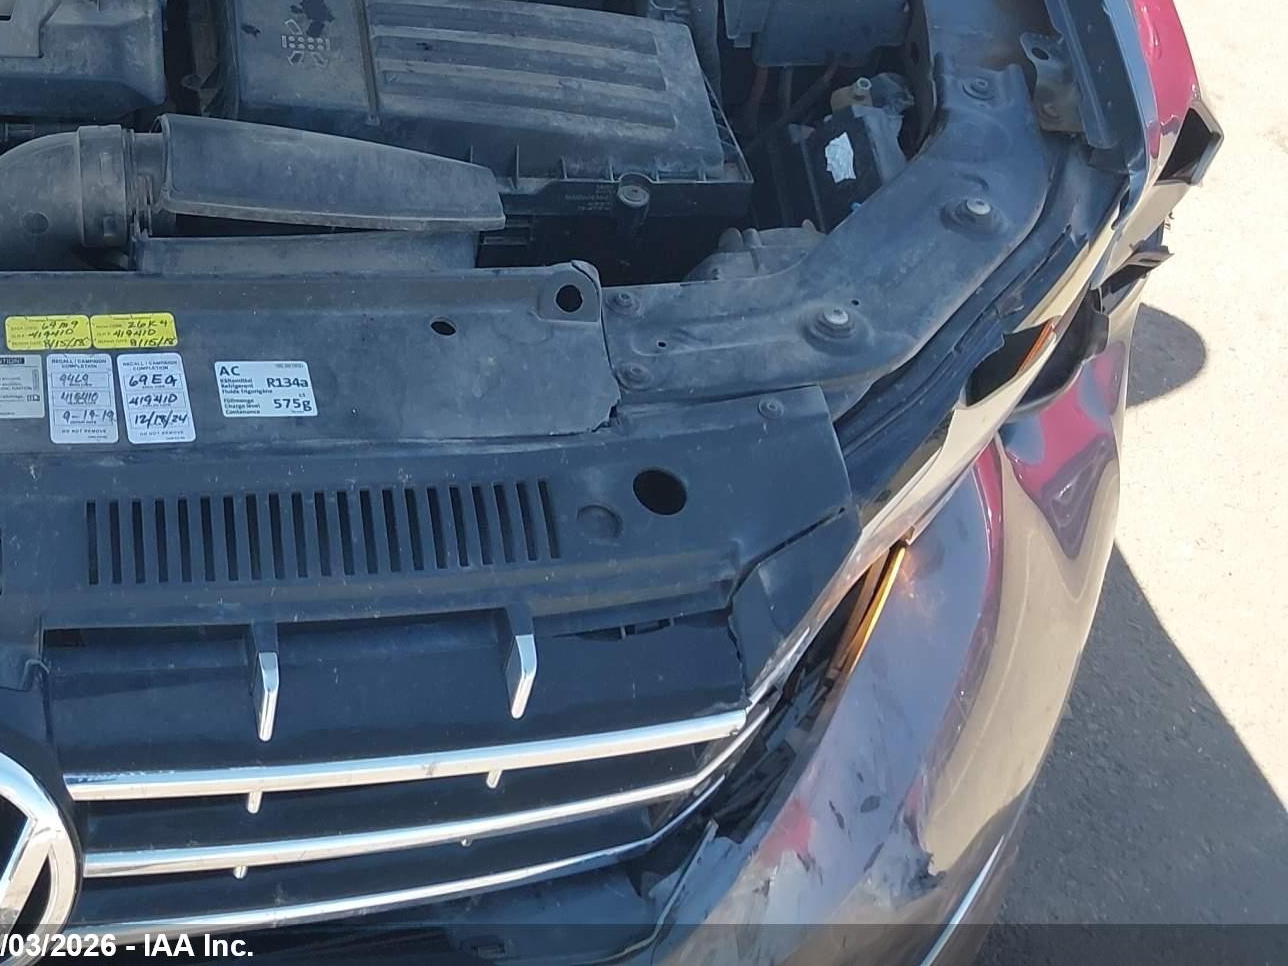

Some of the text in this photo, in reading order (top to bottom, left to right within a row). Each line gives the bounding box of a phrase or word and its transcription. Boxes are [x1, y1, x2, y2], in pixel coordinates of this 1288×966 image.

[220, 366, 240, 376] AC
[266, 378, 308, 388] R134a
[274, 398, 312, 412] 575g
